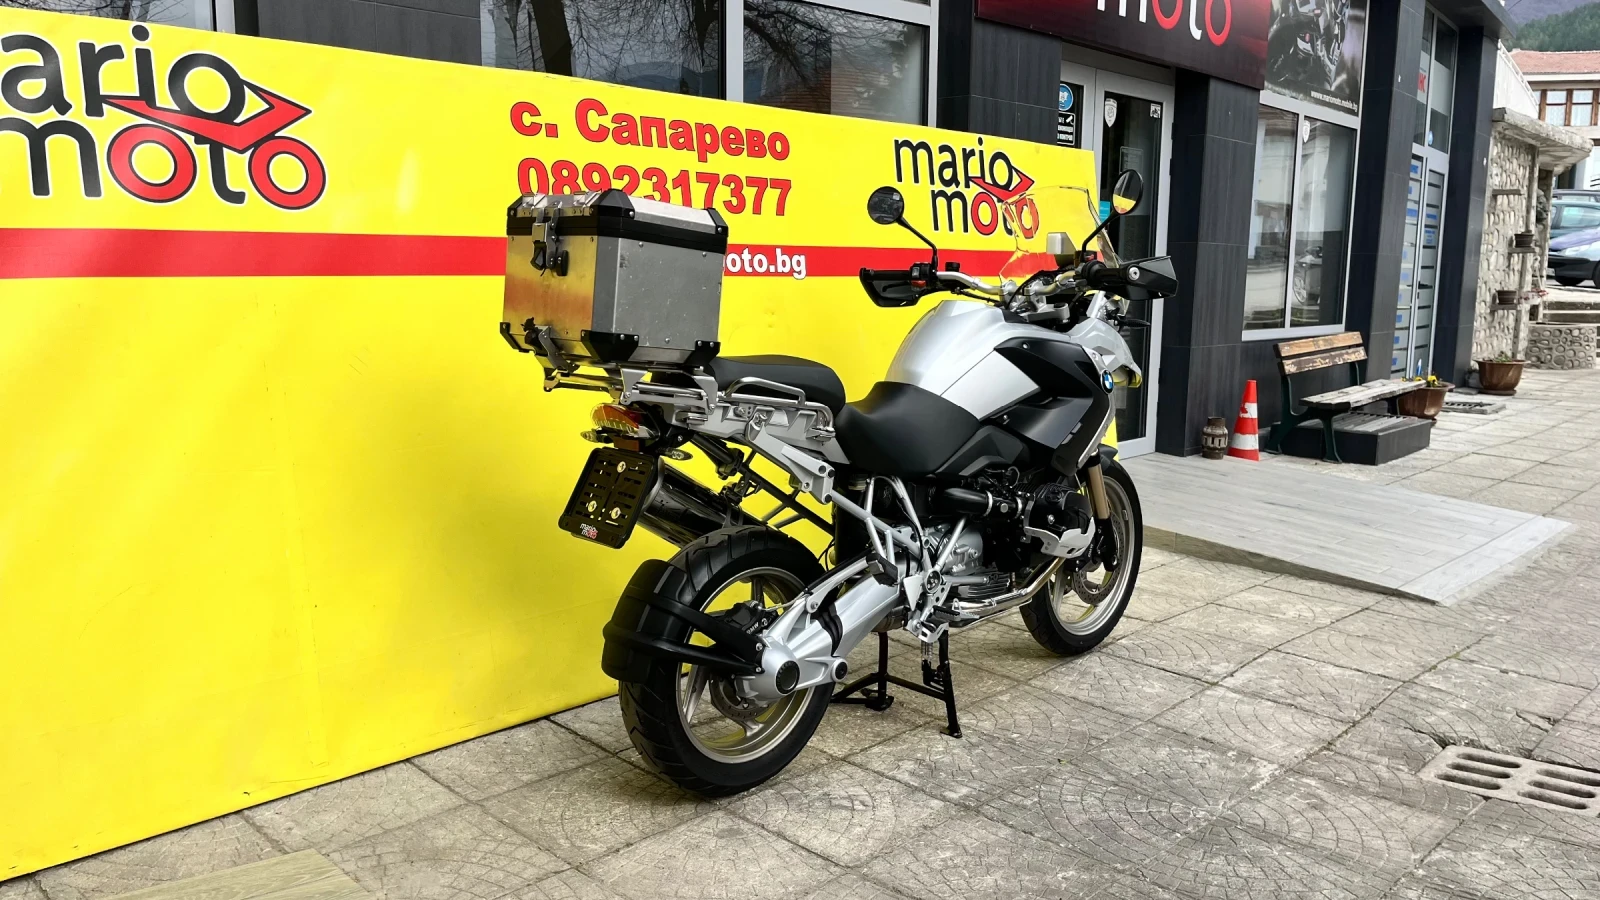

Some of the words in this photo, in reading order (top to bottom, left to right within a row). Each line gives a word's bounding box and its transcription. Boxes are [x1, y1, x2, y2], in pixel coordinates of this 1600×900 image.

[1097, 0, 1232, 46] to
[510, 101, 558, 138] с.
[575, 98, 790, 162] Сапарево
[517, 157, 792, 216] 0892317377
[894, 136, 1013, 191] mario
[931, 188, 1039, 239] moto
[724, 247, 807, 280] oto.bg
